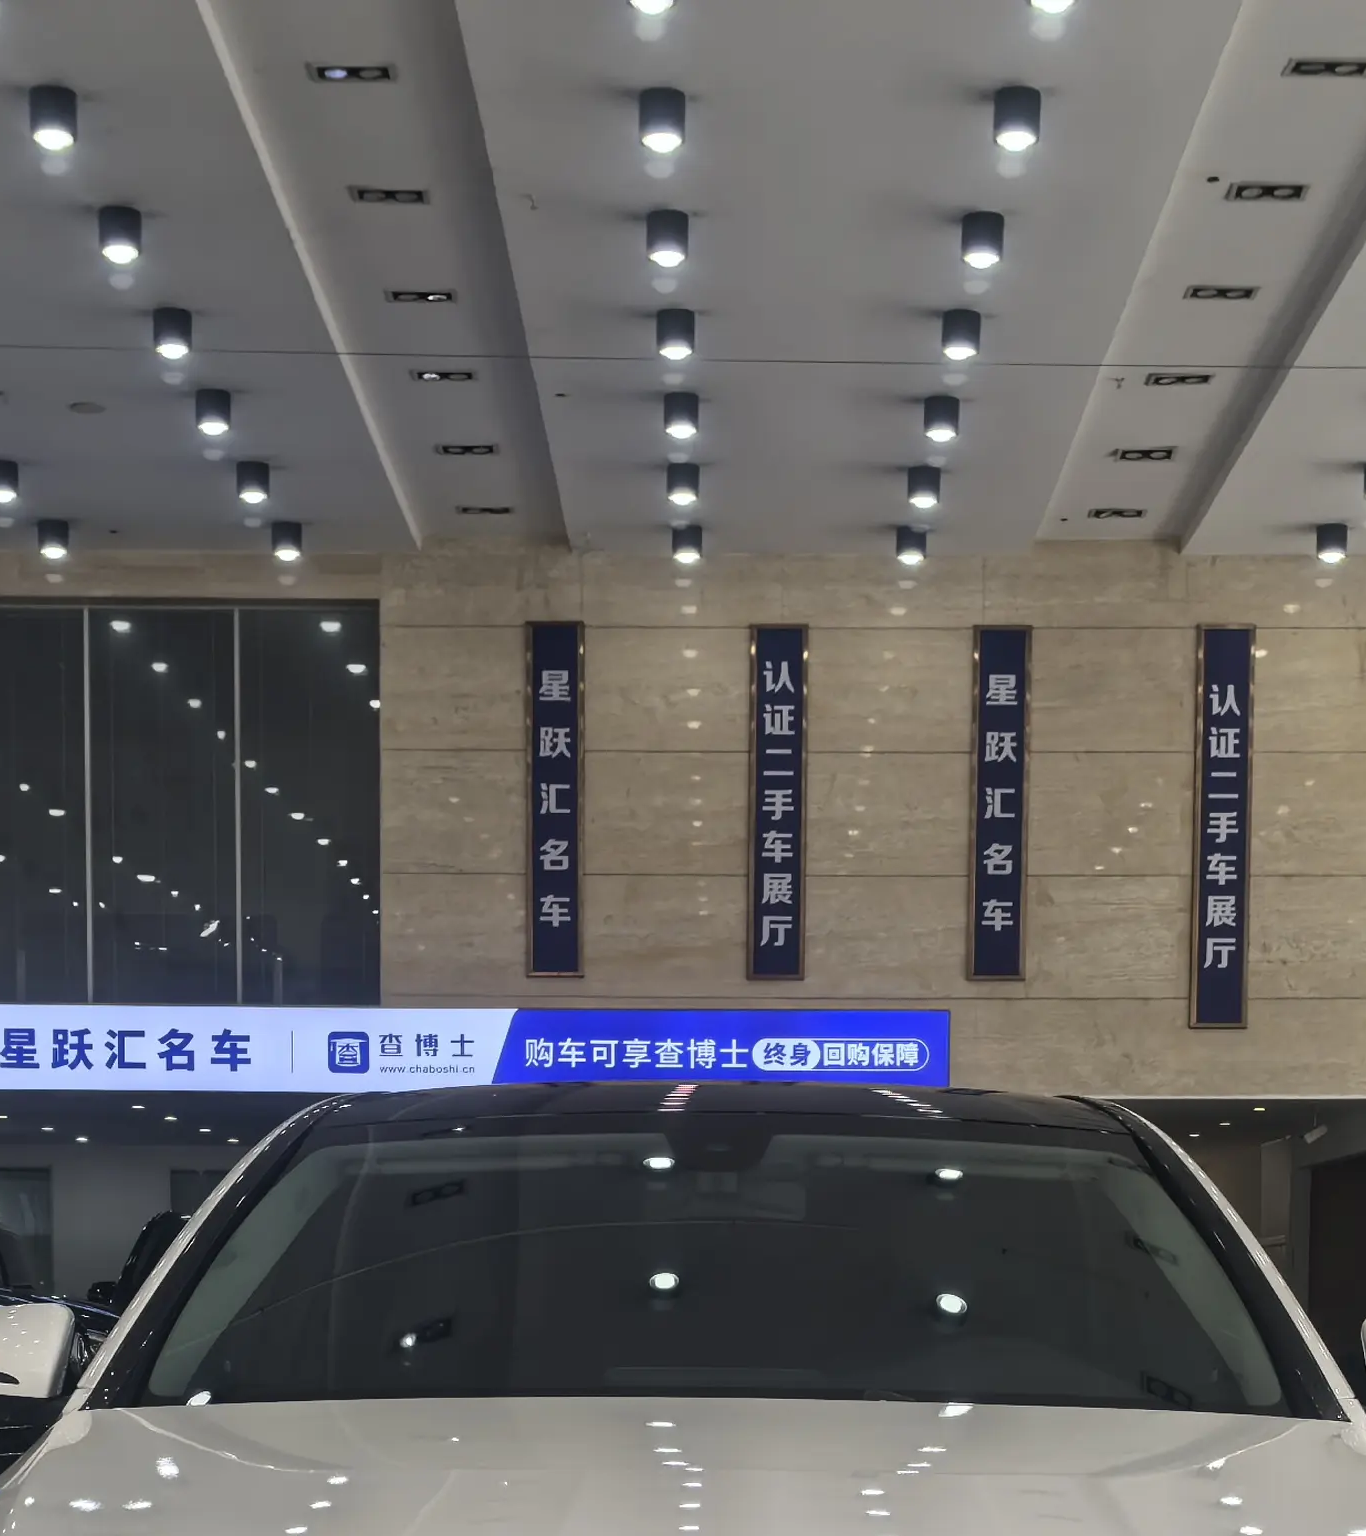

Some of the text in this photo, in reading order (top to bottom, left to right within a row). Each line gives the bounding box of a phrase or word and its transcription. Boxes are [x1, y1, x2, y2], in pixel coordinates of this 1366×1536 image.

[538, 669, 572, 928] 星跃汇名车
[760, 660, 796, 948] 认证二手车展厅
[981, 673, 1018, 932] 星跃汇名车
[1203, 683, 1241, 970] 认证二手车展厅
[378, 1032, 475, 1059] 查博士
[379, 1064, 476, 1075] www.chaboshi.cn
